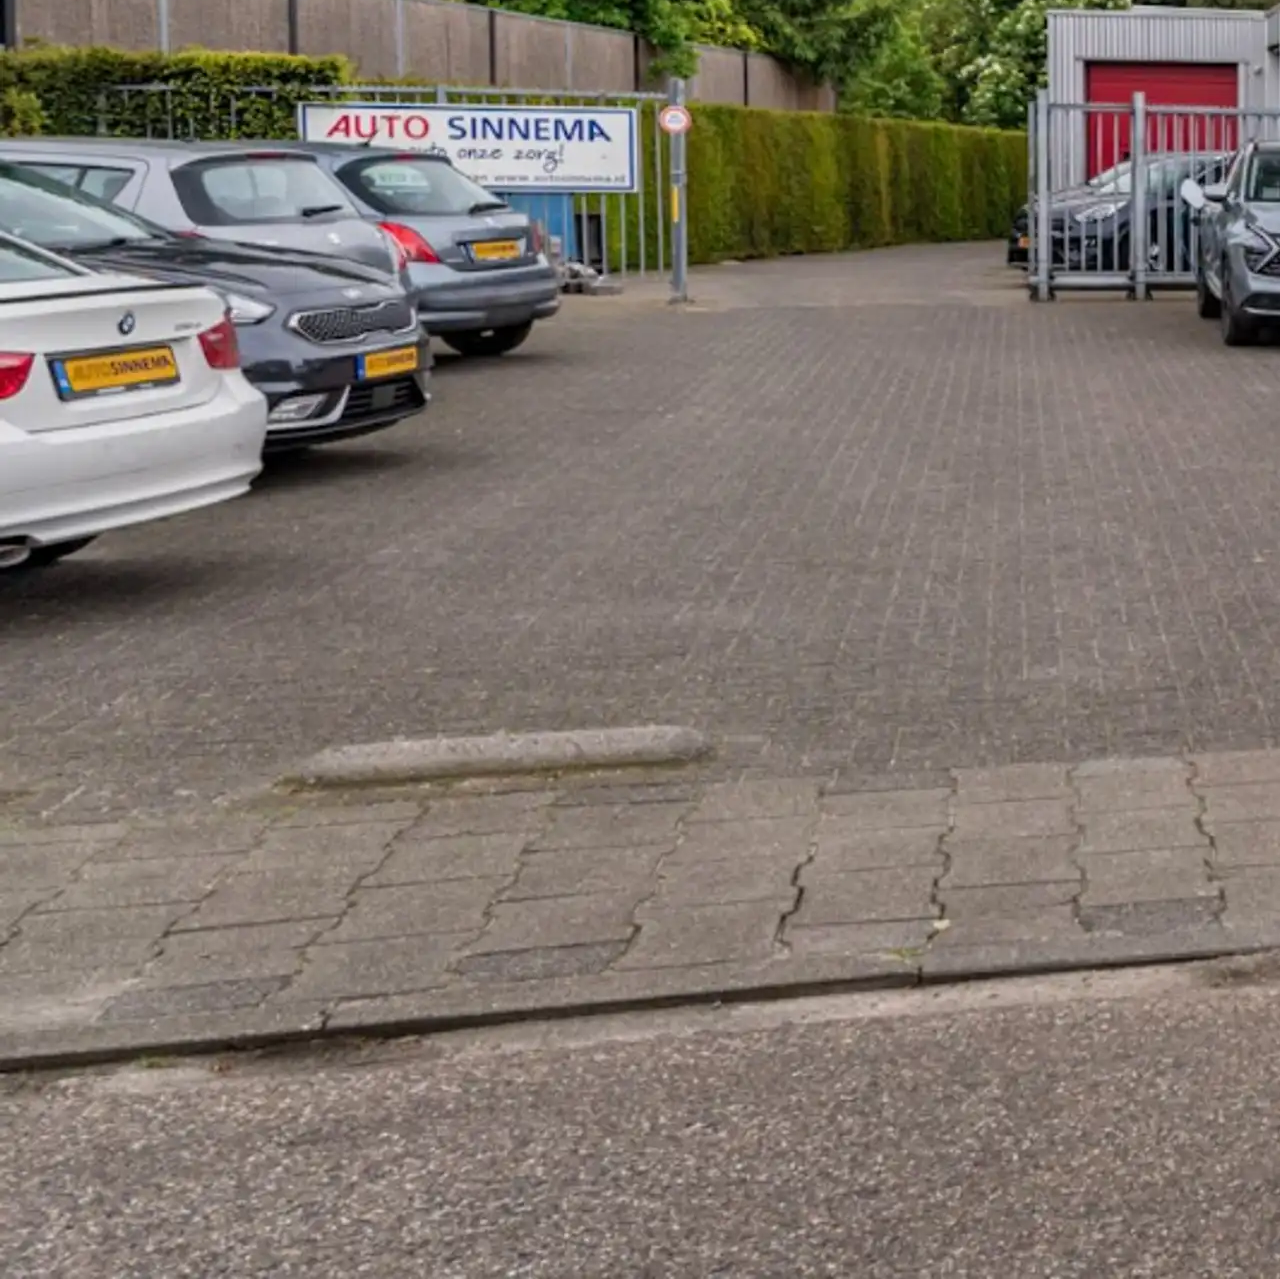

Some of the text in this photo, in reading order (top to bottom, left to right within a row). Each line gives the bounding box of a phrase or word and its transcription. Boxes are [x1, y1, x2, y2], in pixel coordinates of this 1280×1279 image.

[326, 114, 612, 142] AUTO SINNEMA
[456, 147, 503, 161] onze
[513, 144, 565, 174] zorg!
